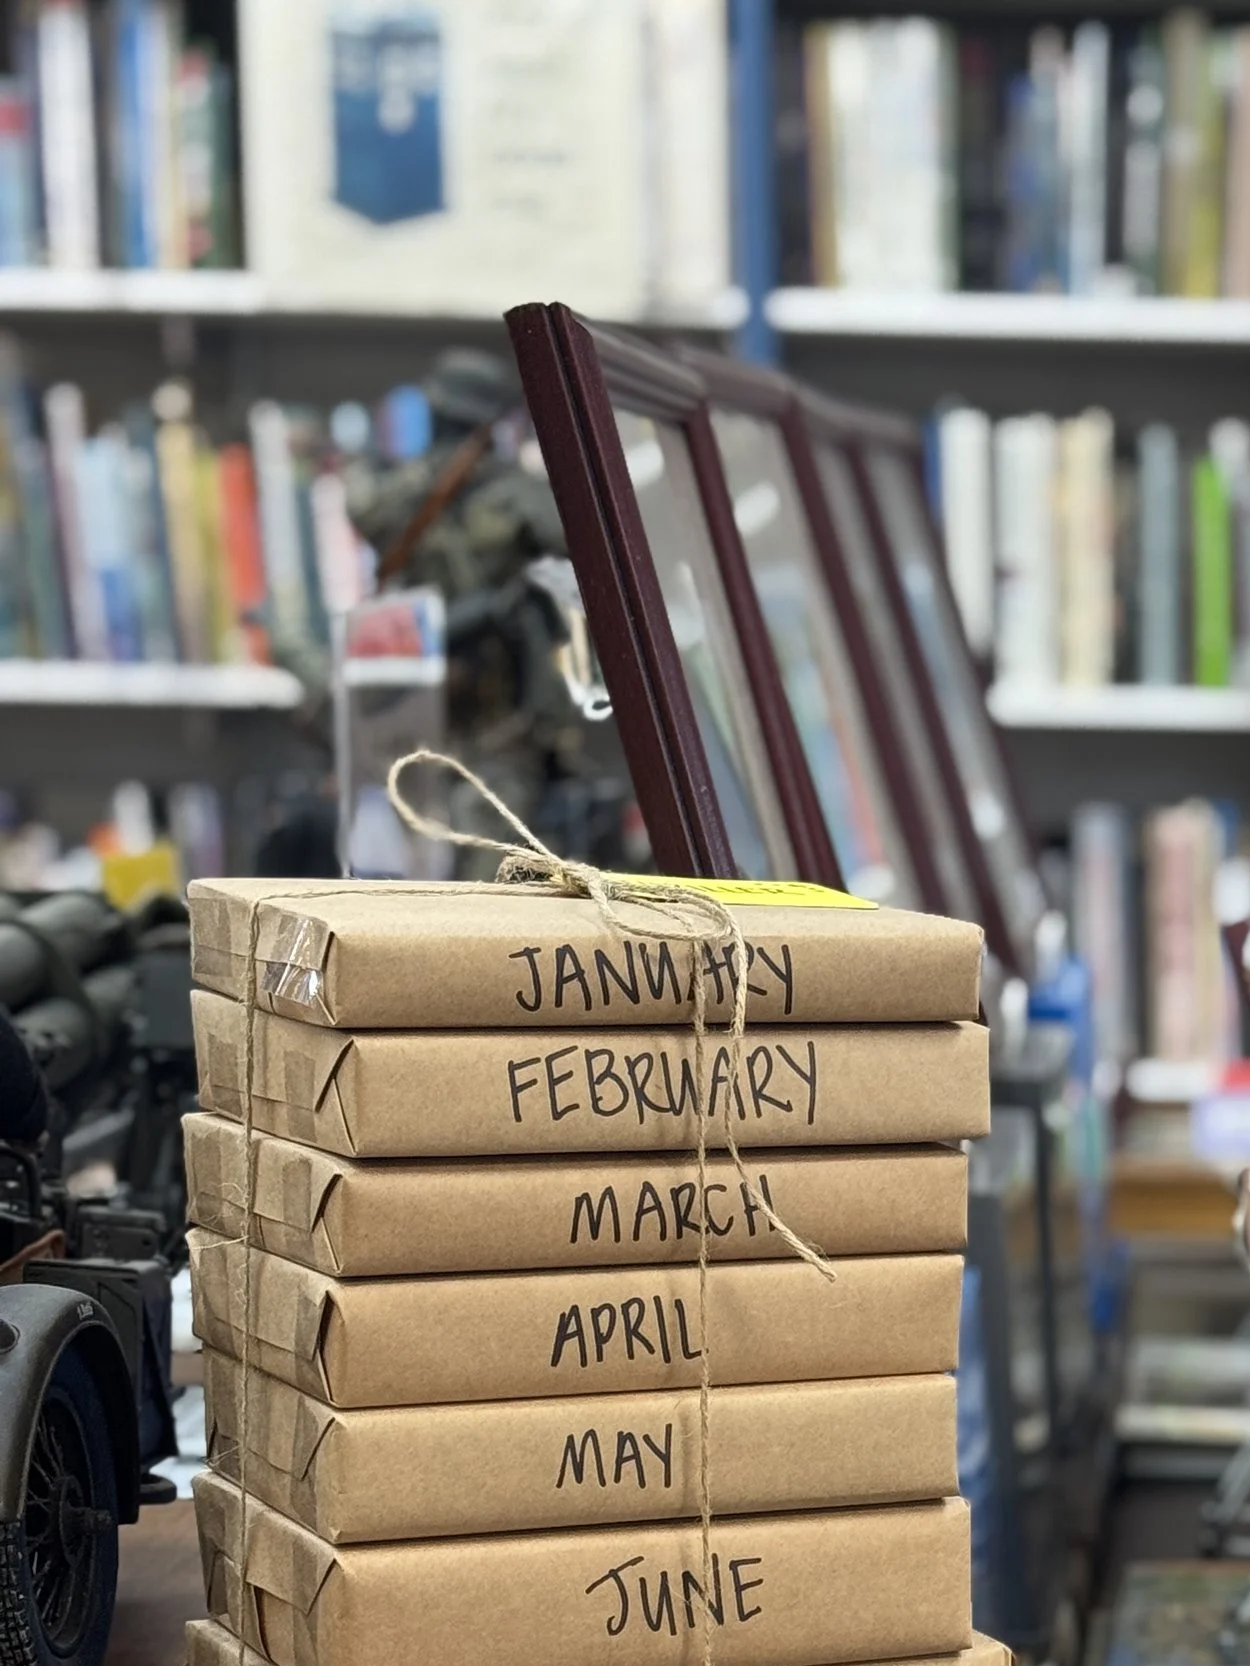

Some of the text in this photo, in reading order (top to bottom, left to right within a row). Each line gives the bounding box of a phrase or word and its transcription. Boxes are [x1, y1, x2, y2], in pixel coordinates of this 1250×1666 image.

[509, 940, 793, 1015] JANUARY
[508, 1041, 817, 1125] FEBRUARY
[569, 1174, 776, 1244] MARCH
[550, 1295, 709, 1368] APRIL
[555, 1422, 674, 1490] MAY
[585, 1552, 764, 1636] JUNE
